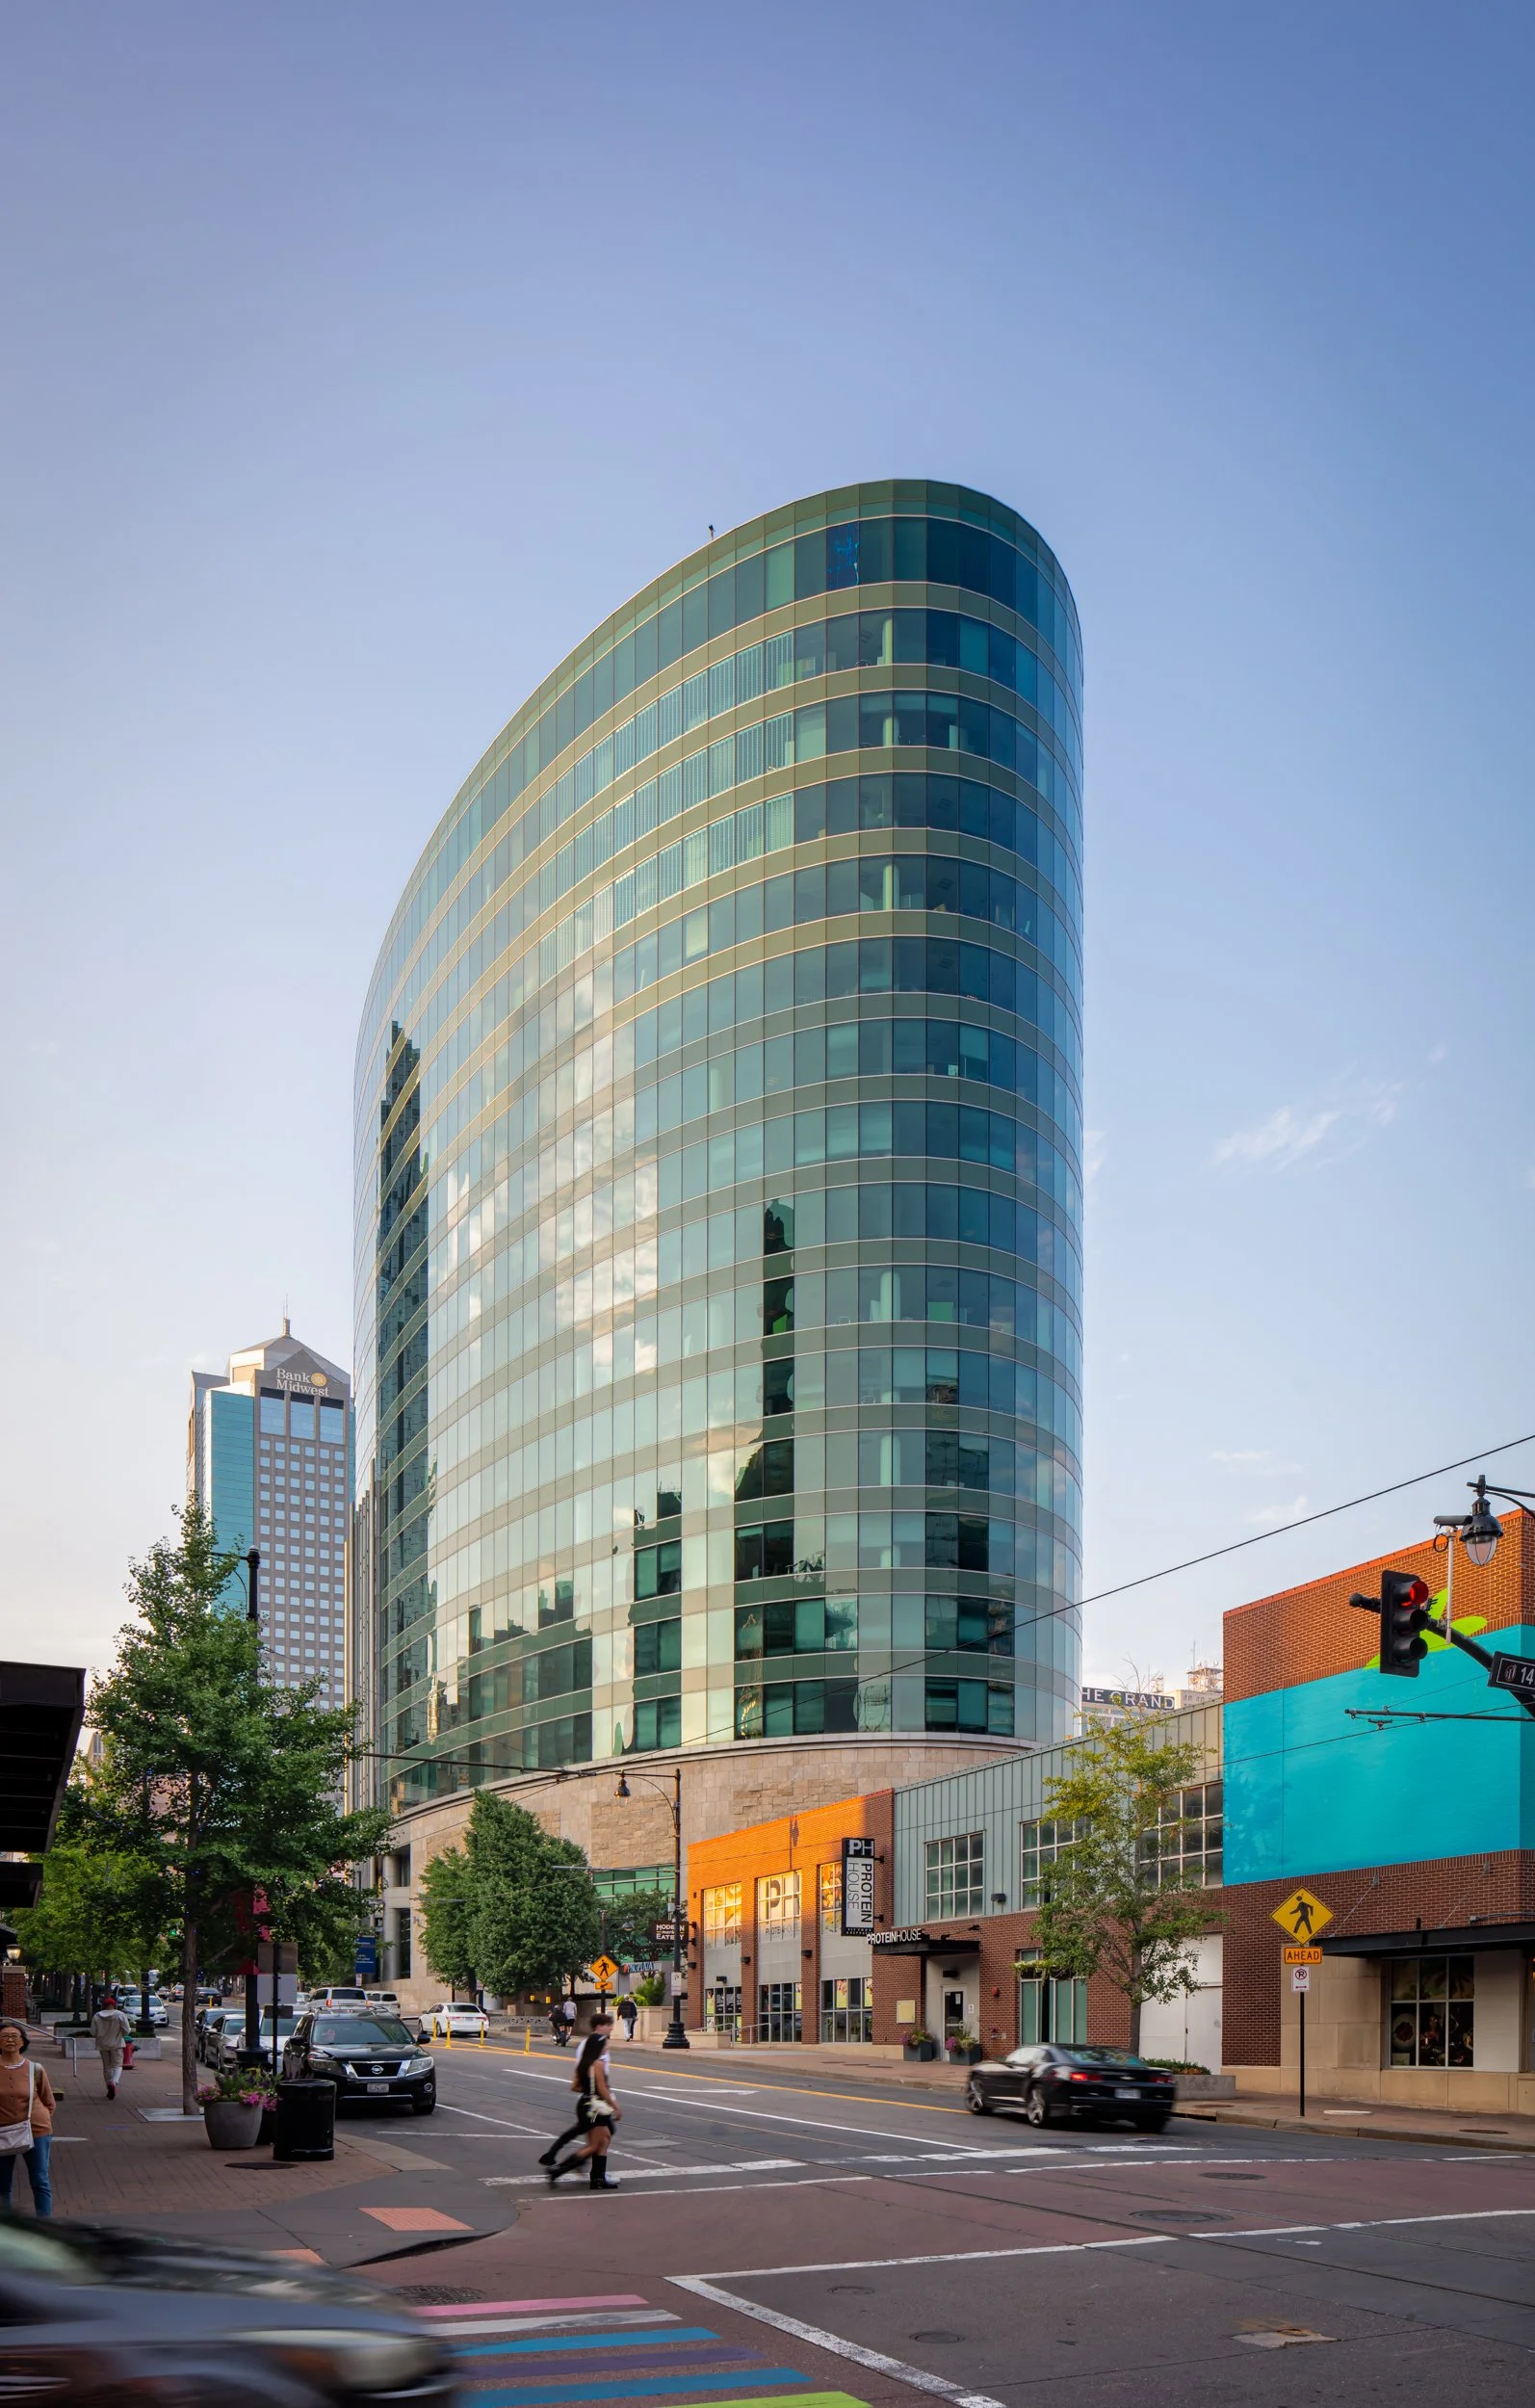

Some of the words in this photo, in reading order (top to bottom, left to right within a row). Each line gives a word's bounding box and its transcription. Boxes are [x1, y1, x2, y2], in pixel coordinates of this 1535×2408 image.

[276, 1368, 311, 1383] Bank
[276, 1379, 329, 1397] Midwest
[1081, 1688, 1105, 1702] HE
[848, 1839, 874, 1856] PH
[847, 1862, 859, 1909] HOUSE
[861, 1863, 872, 1923] PROTEIN
[867, 1928, 922, 1944] PROTEINHOUSE
[1287, 1950, 1319, 1960] AHEAD
